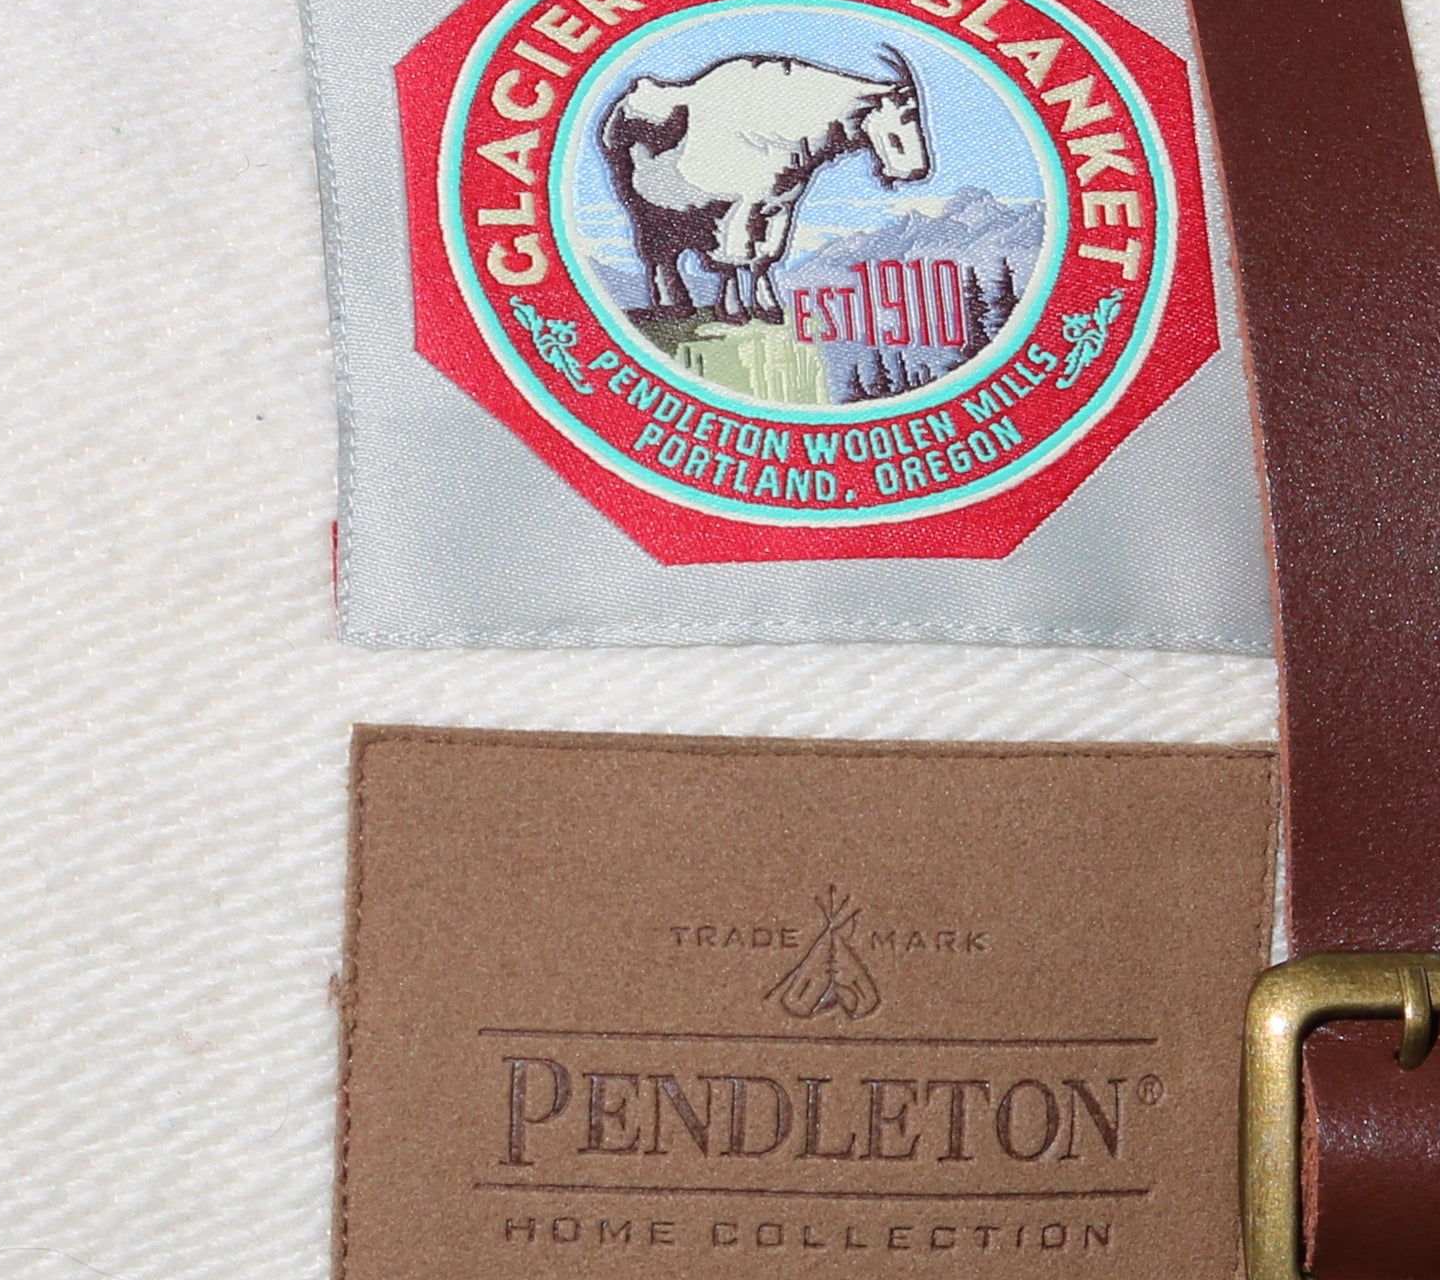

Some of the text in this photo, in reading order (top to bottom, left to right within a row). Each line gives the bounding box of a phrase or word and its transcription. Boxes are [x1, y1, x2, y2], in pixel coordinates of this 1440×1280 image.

[793, 257, 967, 349] EST 1910
[587, 340, 1060, 466] PENDLETON WOOLEN MILLS
[874, 415, 1025, 496] OREGON
[668, 924, 990, 954] TRADE MARK
[502, 1214, 1115, 1254] HOME COLLECTION
